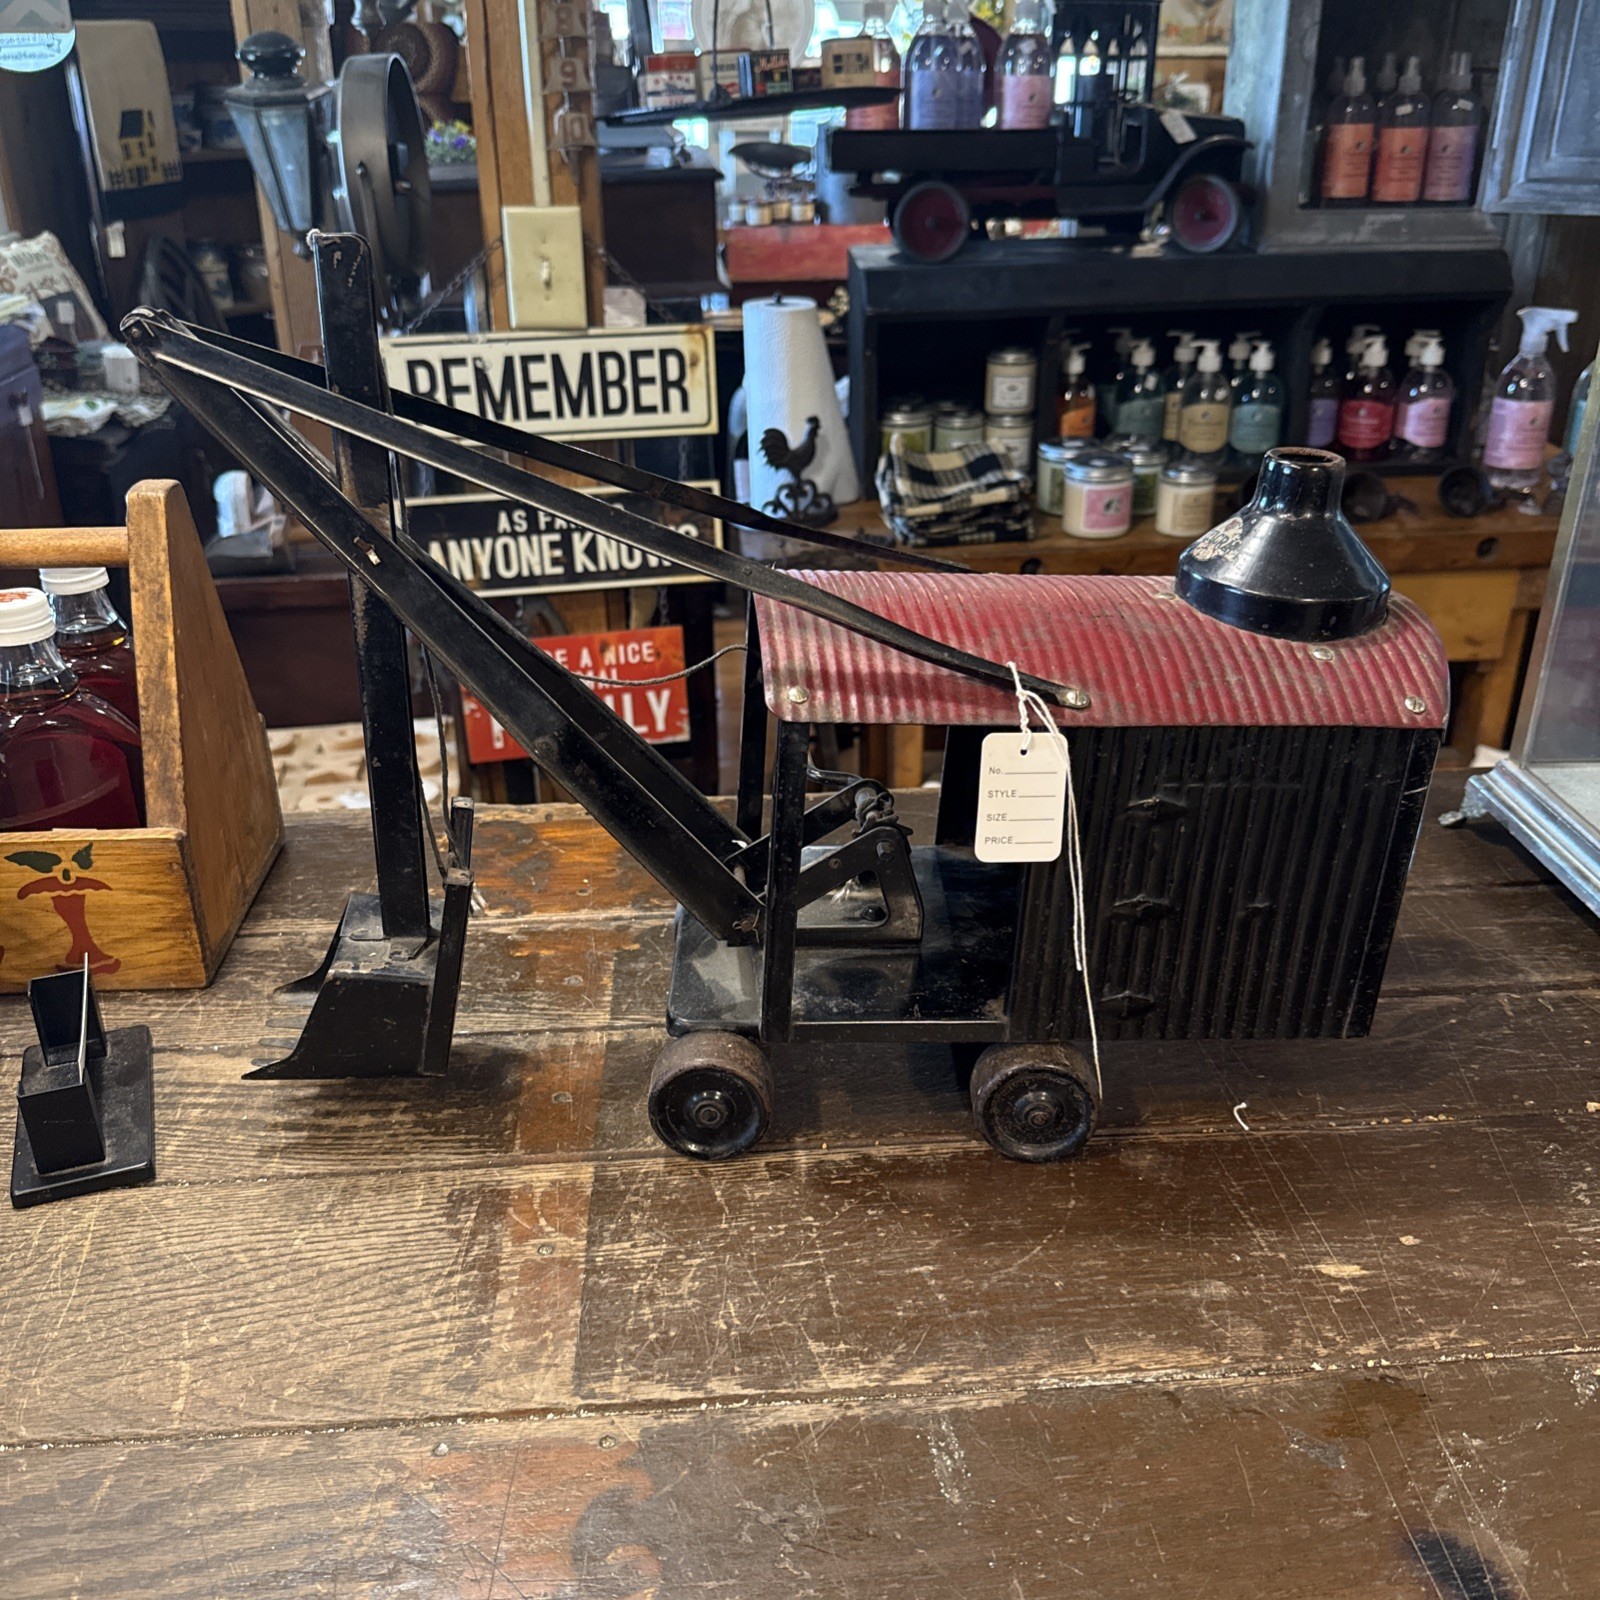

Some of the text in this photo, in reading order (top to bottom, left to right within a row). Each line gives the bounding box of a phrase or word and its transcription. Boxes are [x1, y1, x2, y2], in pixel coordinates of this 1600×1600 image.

[560, 60, 577, 88] 9
[563, 115, 585, 144] 10
[406, 347, 690, 422] REMEMBER
[497, 509, 577, 533] AS FA
[428, 532, 566, 582] ANYONE
[579, 647, 594, 668] A
[604, 641, 656, 667] NICE
[988, 766, 1003, 775] No.
[987, 789, 1017, 799] STYLE
[986, 813, 1007, 822] SIZE
[984, 836, 1013, 845] PRICE
